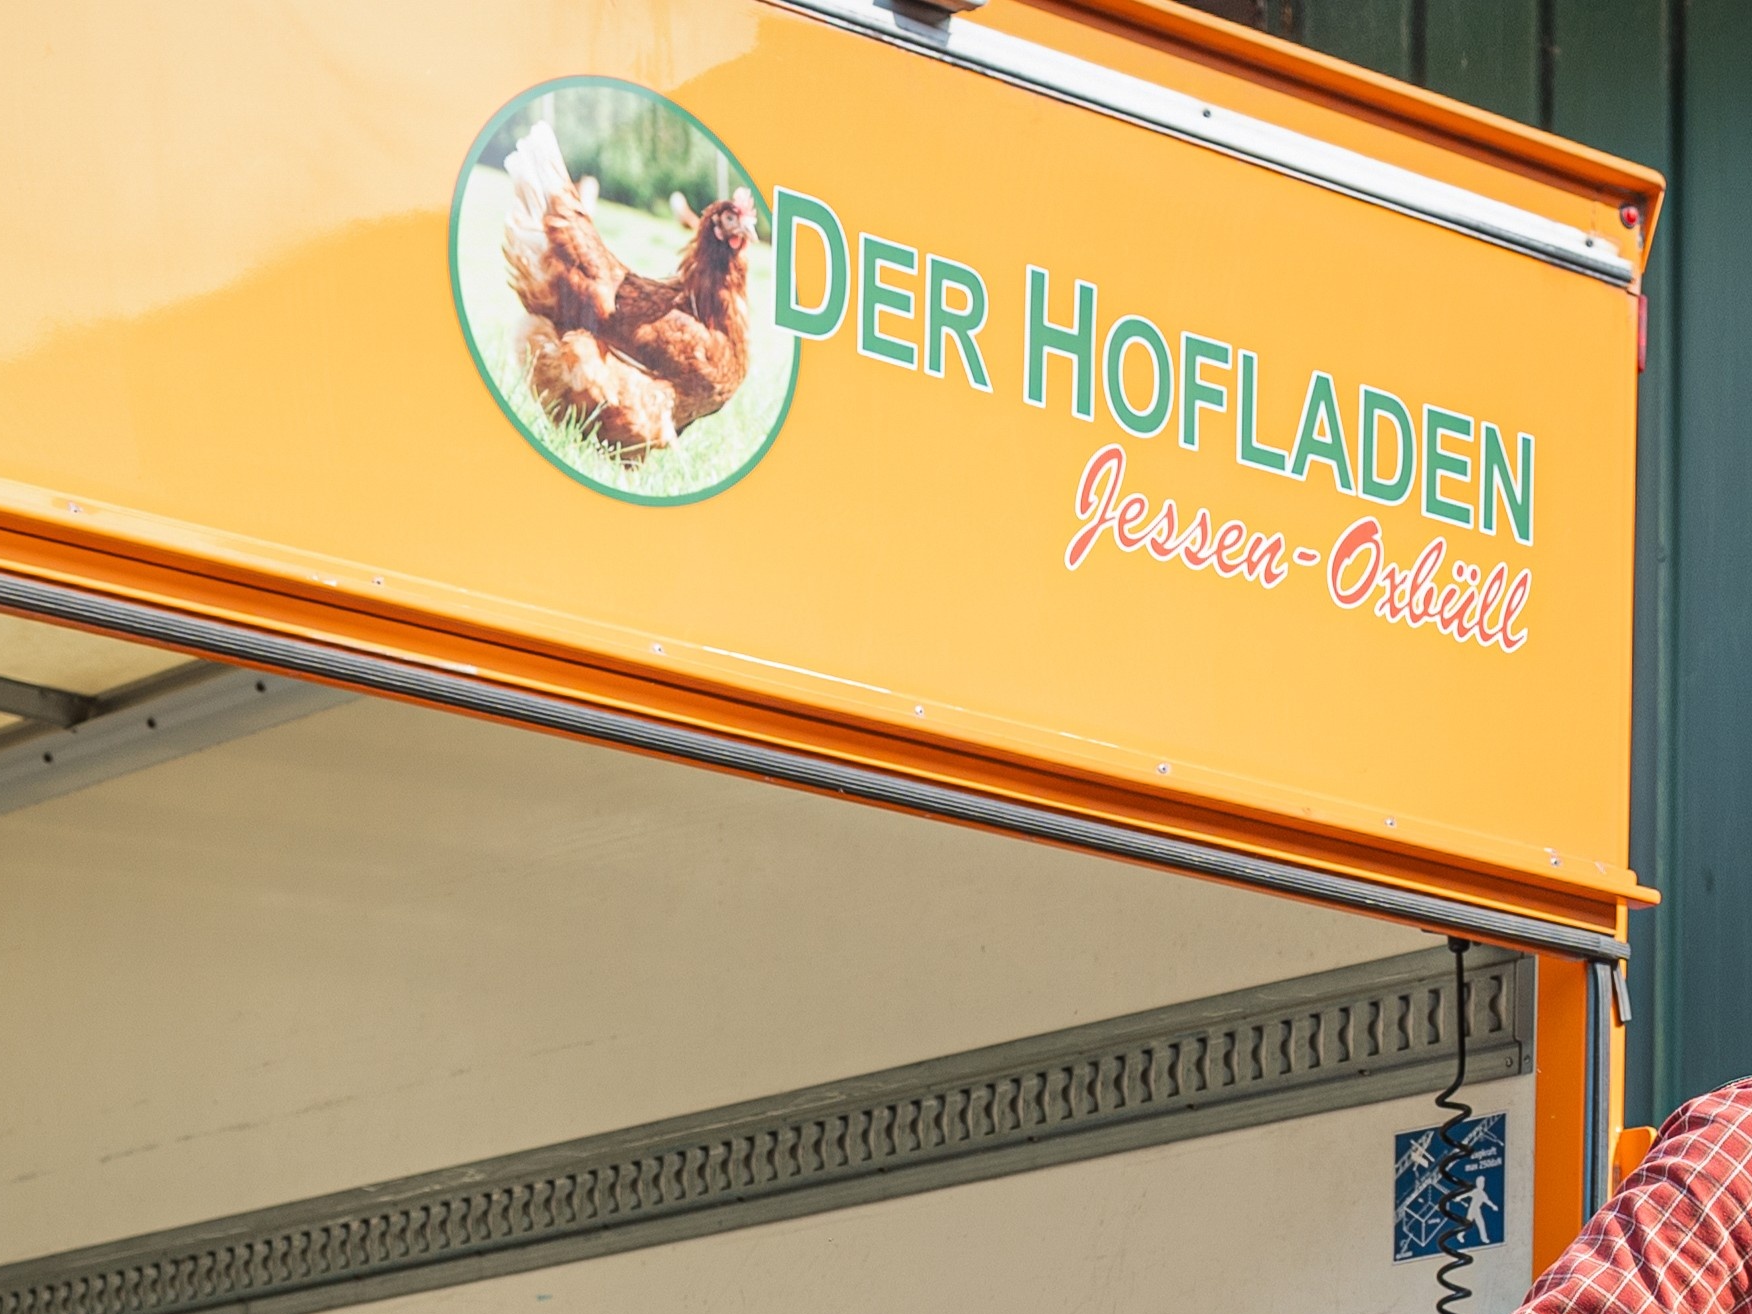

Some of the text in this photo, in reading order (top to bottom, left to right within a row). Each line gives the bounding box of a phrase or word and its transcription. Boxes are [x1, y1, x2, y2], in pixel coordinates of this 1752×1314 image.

[774, 188, 1536, 546] DER HOFLADEN
[1064, 444, 1531, 654] Jessen-Oxbüll
